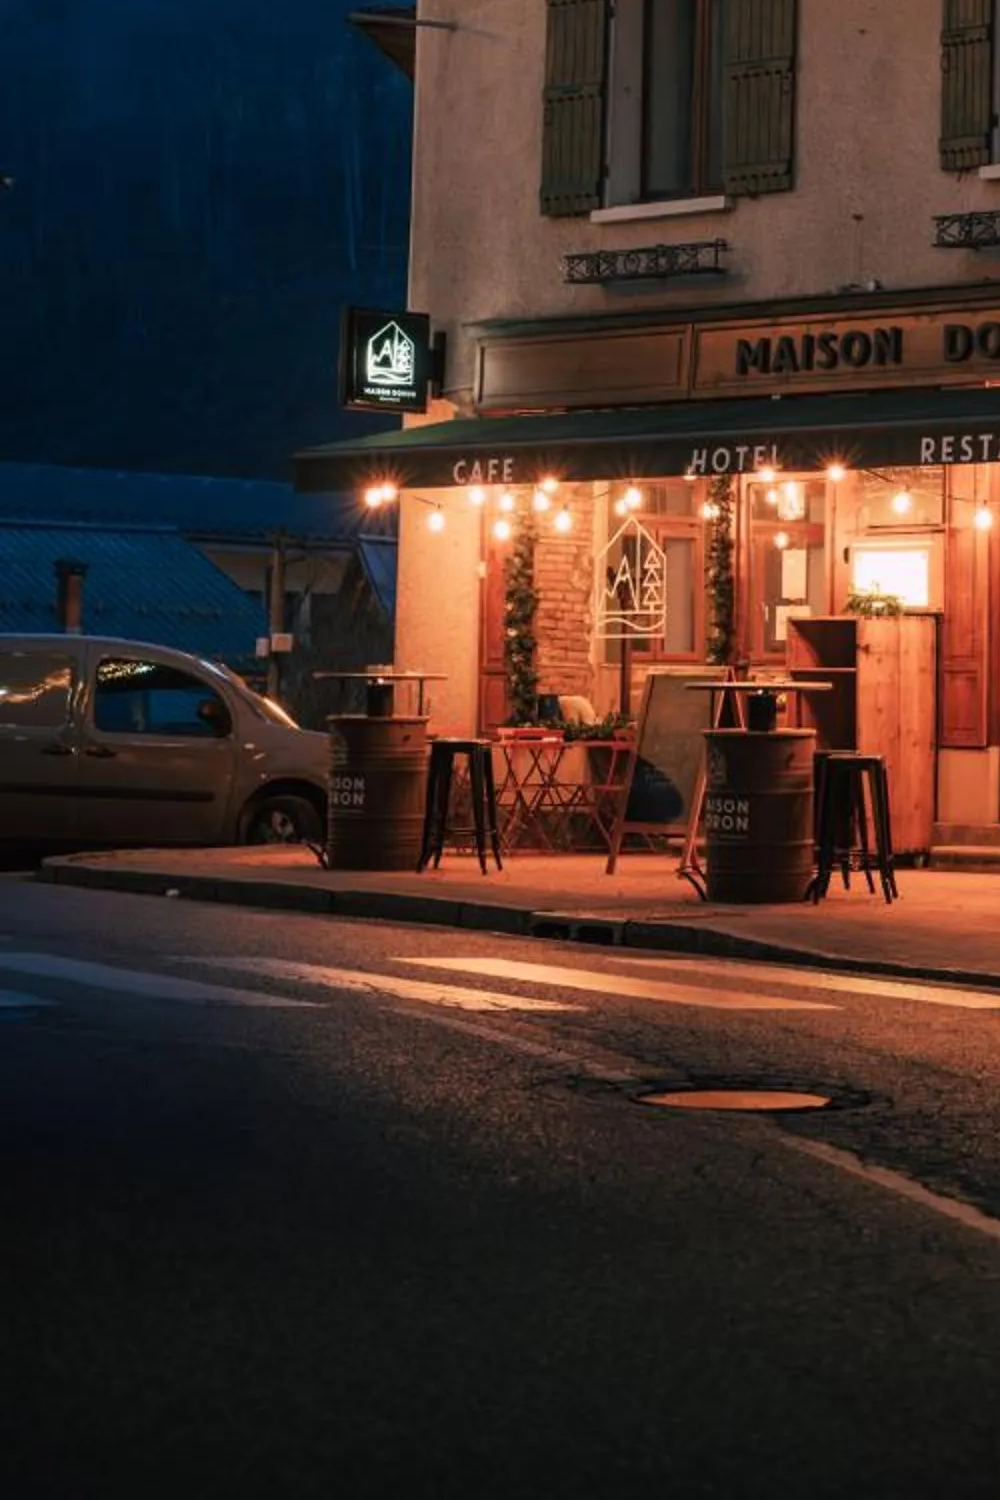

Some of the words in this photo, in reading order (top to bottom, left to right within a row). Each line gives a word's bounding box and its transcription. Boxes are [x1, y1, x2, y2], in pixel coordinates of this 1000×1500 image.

[735, 326, 904, 376] MAISON
[453, 458, 514, 484] CAFE
[691, 444, 783, 473] HOTEL
